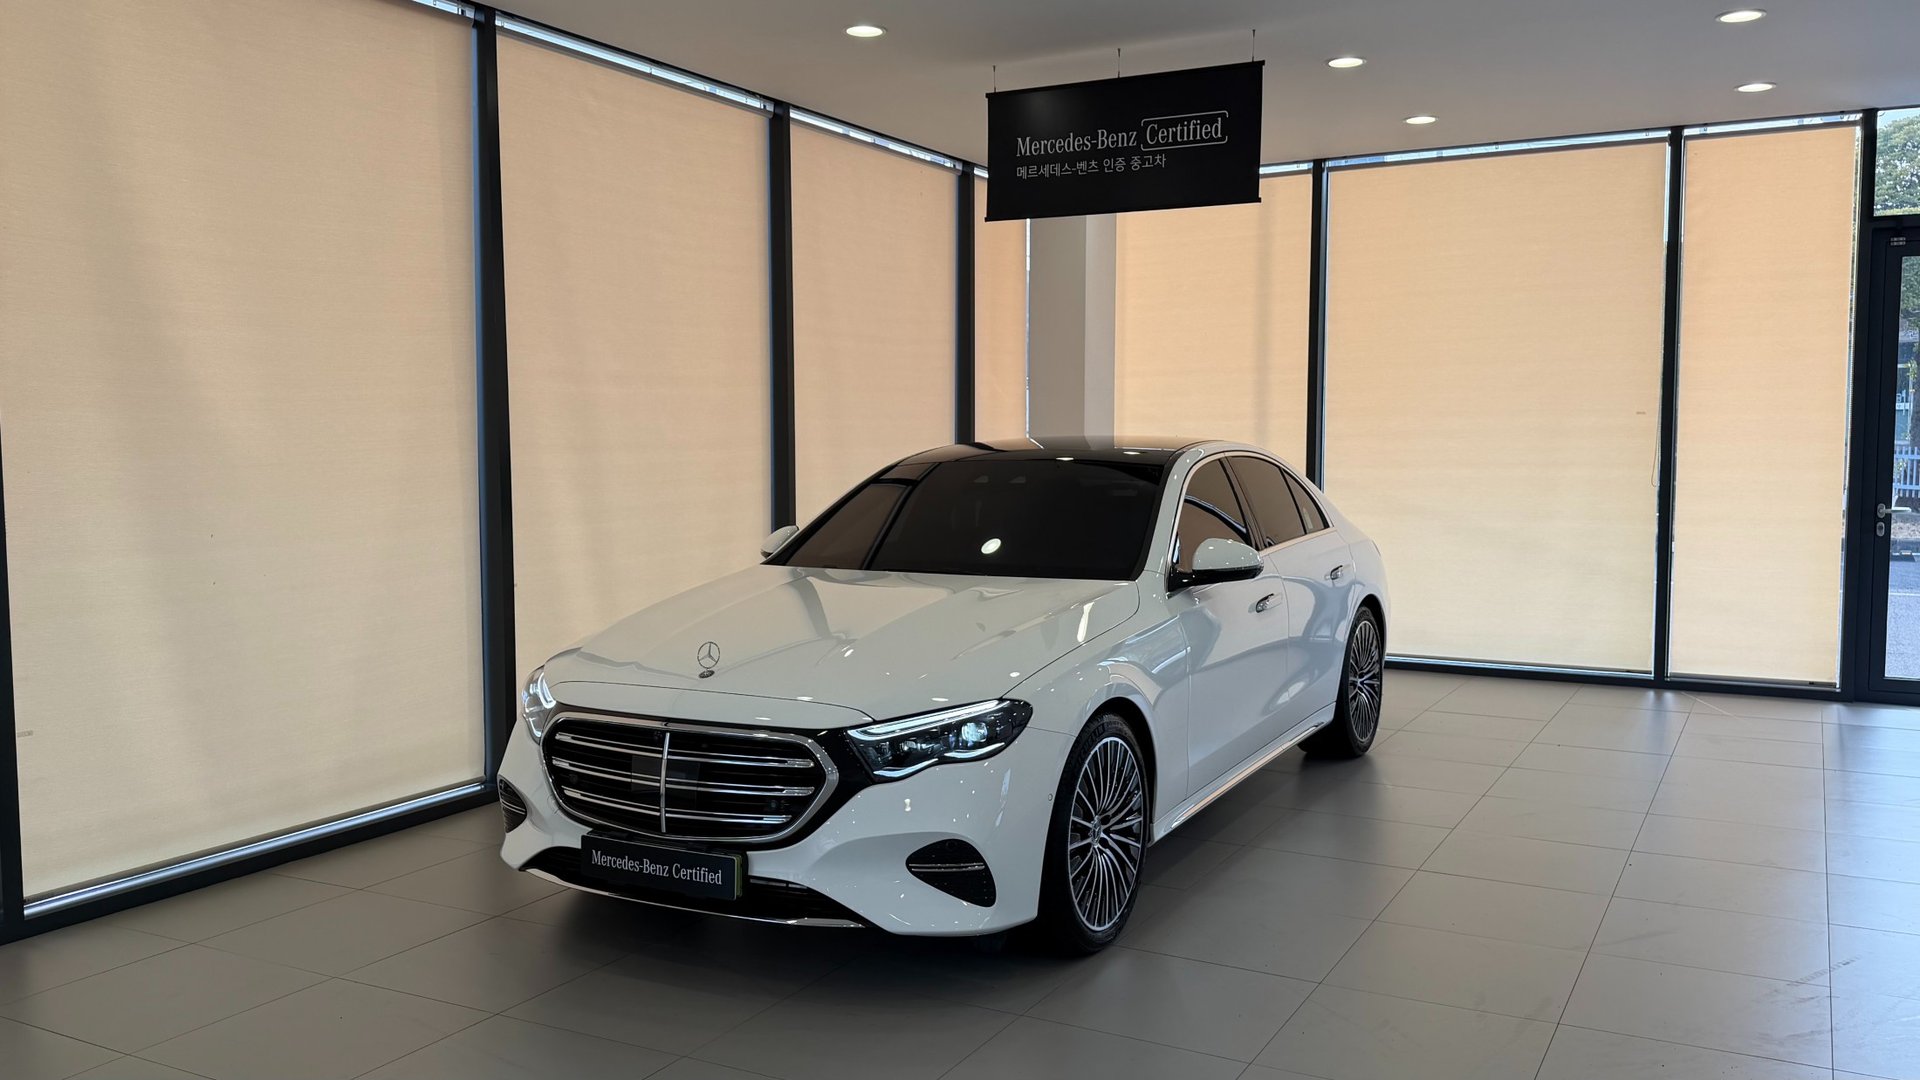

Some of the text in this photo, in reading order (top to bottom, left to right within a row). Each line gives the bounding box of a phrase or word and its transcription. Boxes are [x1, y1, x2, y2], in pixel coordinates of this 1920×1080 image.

[1016, 117, 1222, 157] Mercedes-Benz Certified
[1016, 153, 1167, 180] 메르세데스-벤츠 인증 중고차
[591, 849, 722, 885] Mercedes-Benz Certified
